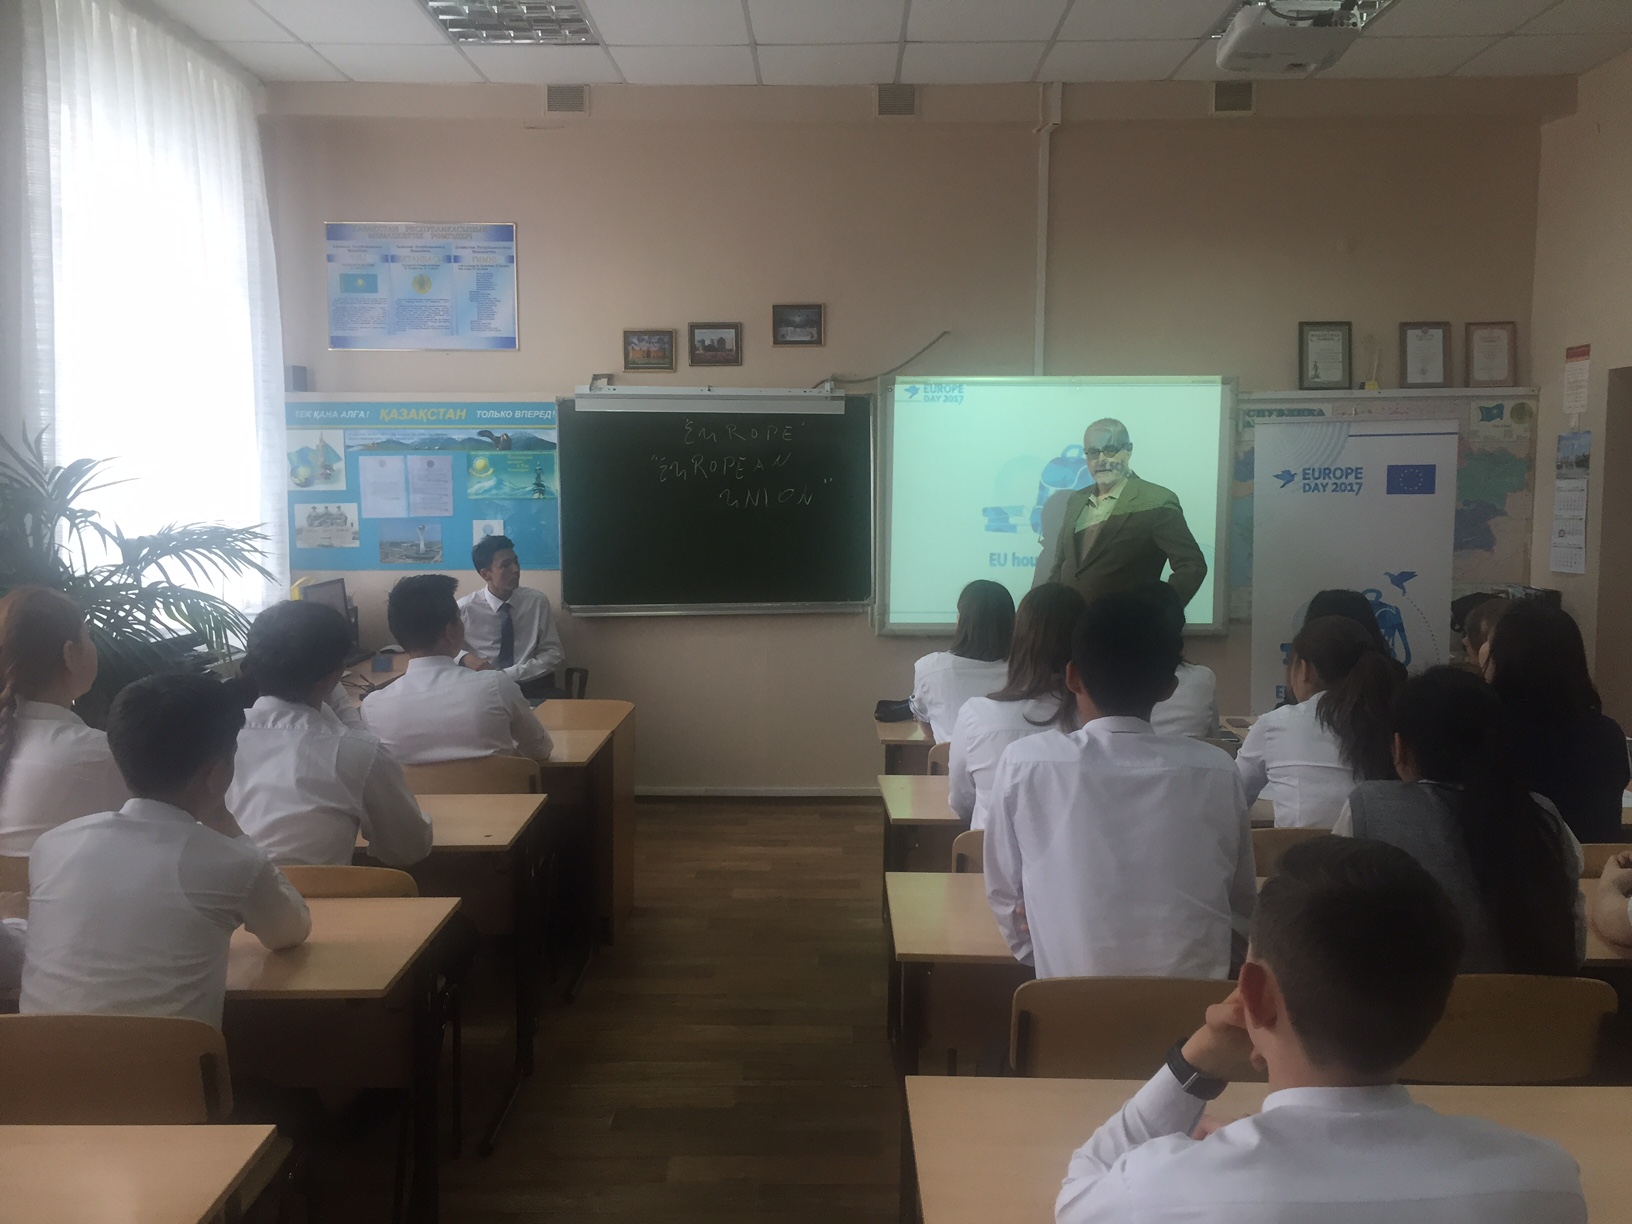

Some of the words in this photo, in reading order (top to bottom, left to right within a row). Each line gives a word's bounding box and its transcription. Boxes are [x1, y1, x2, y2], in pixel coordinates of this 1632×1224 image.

[923, 383, 964, 394] EUROPE
[923, 395, 941, 403] DAY
[942, 395, 964, 406] 2017
[295, 410, 311, 418] ТЕК
[380, 408, 467, 422] ҚАЗАҚСТАН
[476, 410, 513, 418] ТОЛЬКО
[514, 410, 556, 420] ВПЕРЕД!
[1302, 466, 1363, 480] EUROPE
[1303, 482, 1329, 493] DAY
[1331, 482, 1363, 496] 2017
[989, 552, 1008, 568] EU
[1012, 551, 1038, 568] hou
